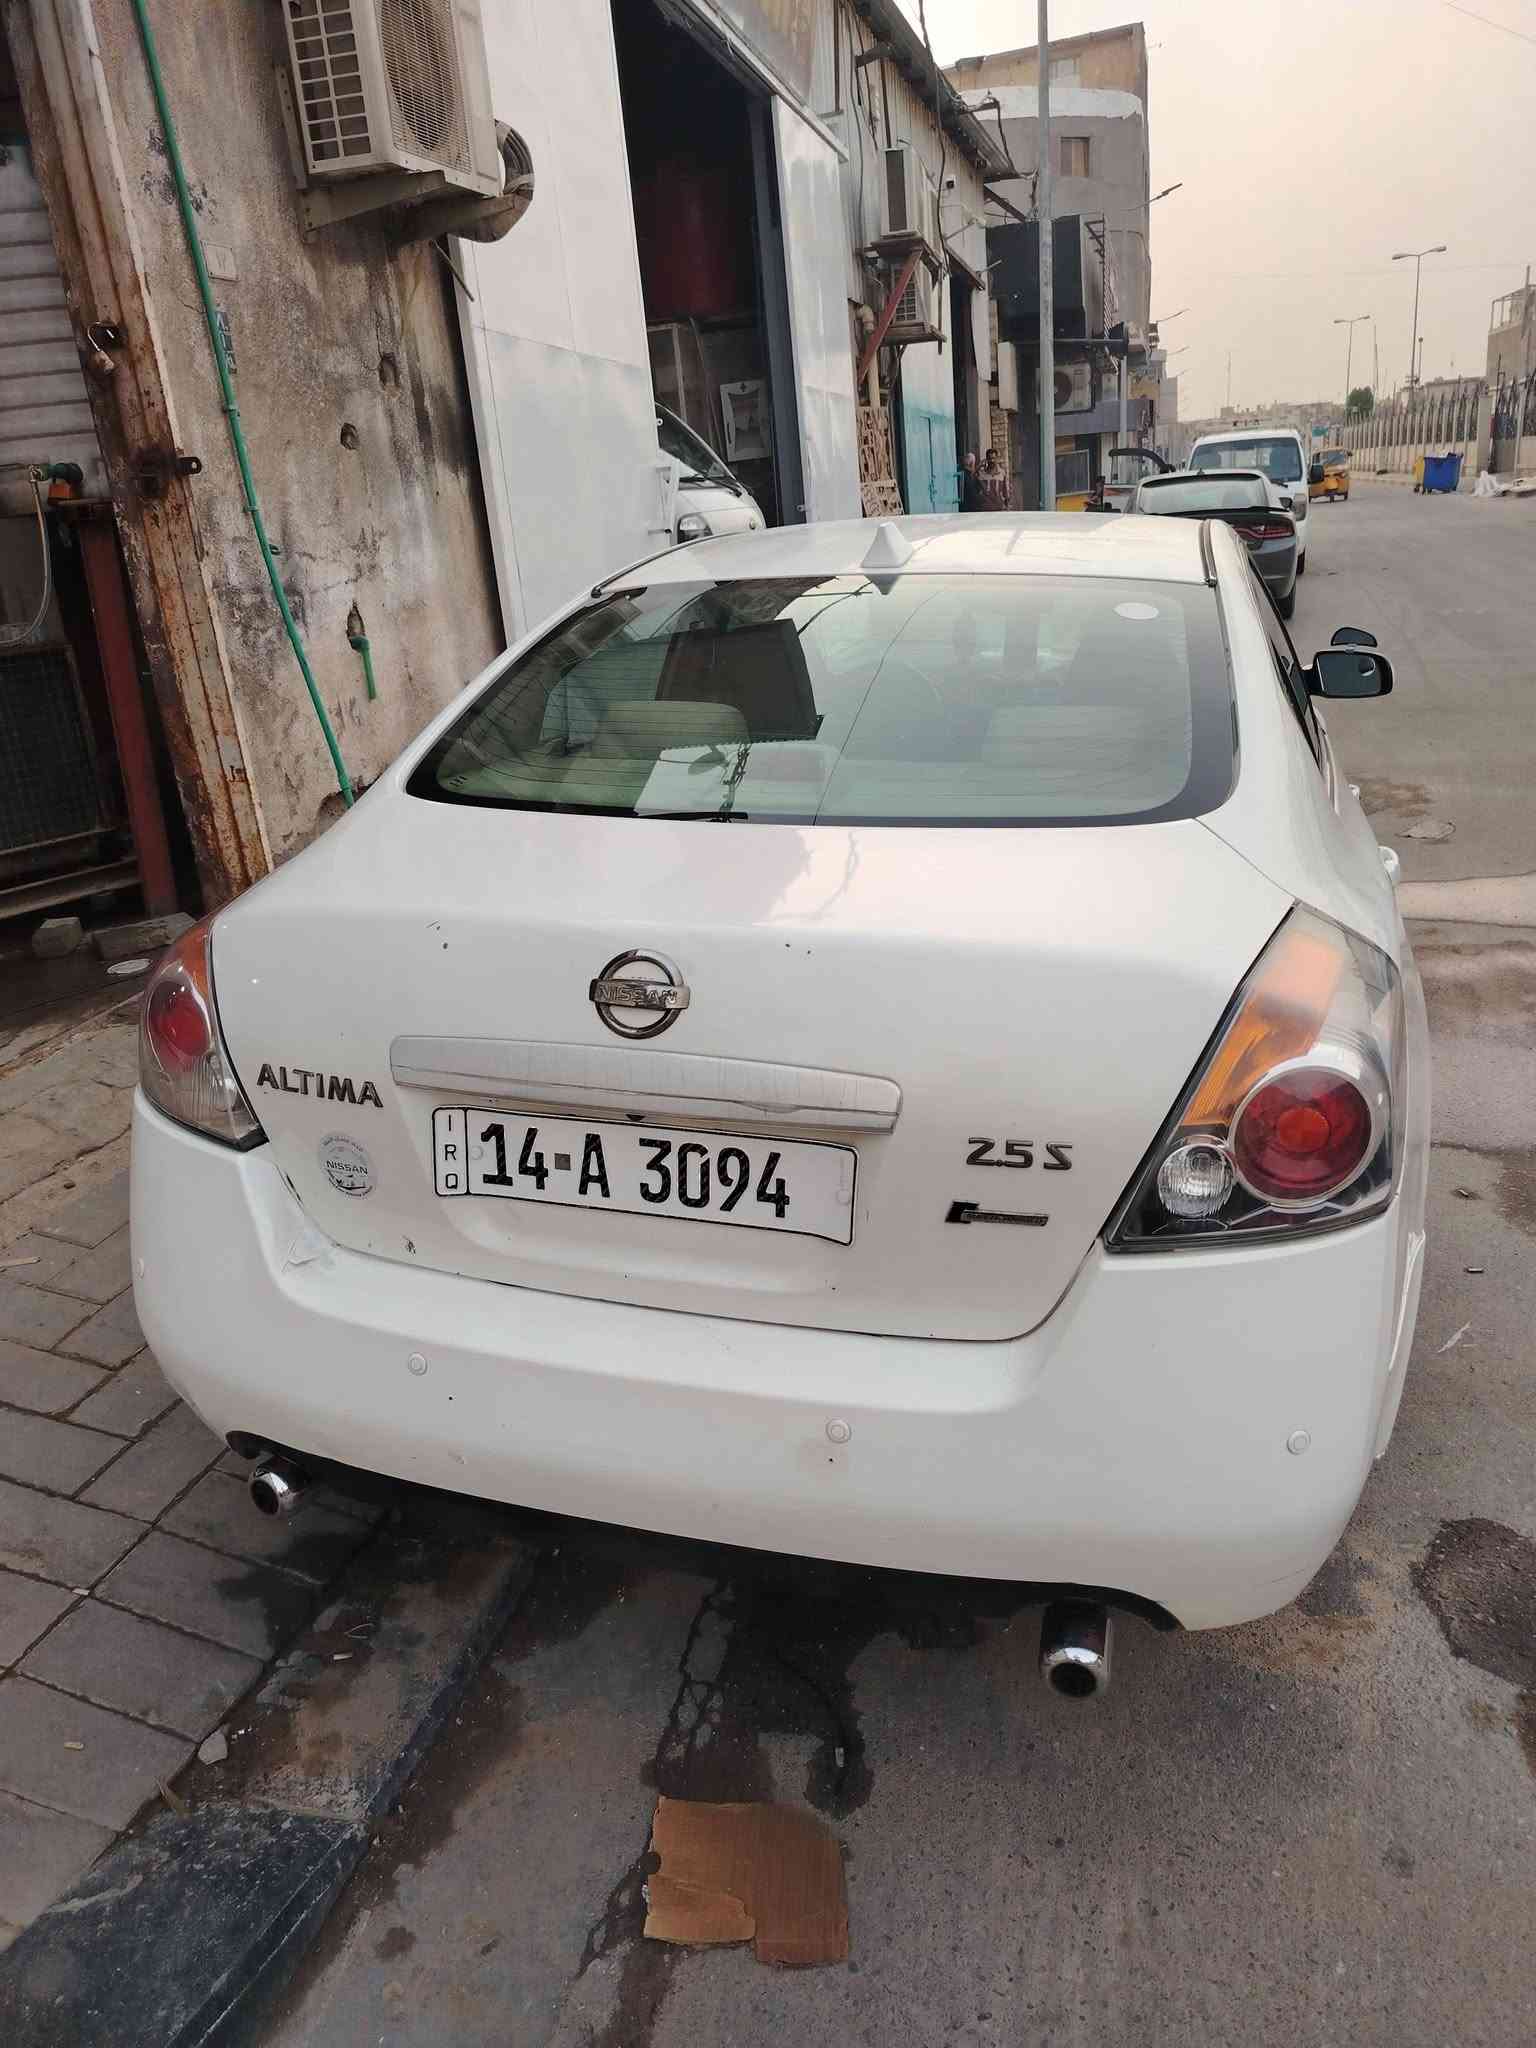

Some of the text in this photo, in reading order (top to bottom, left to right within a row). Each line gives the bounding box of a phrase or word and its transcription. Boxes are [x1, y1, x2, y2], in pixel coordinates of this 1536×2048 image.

[597, 982, 679, 1007] NISSAN
[257, 1063, 384, 1108] ALTIMA
[325, 1159, 369, 1176] NISSAN
[638, 1138, 790, 1218] 3094
